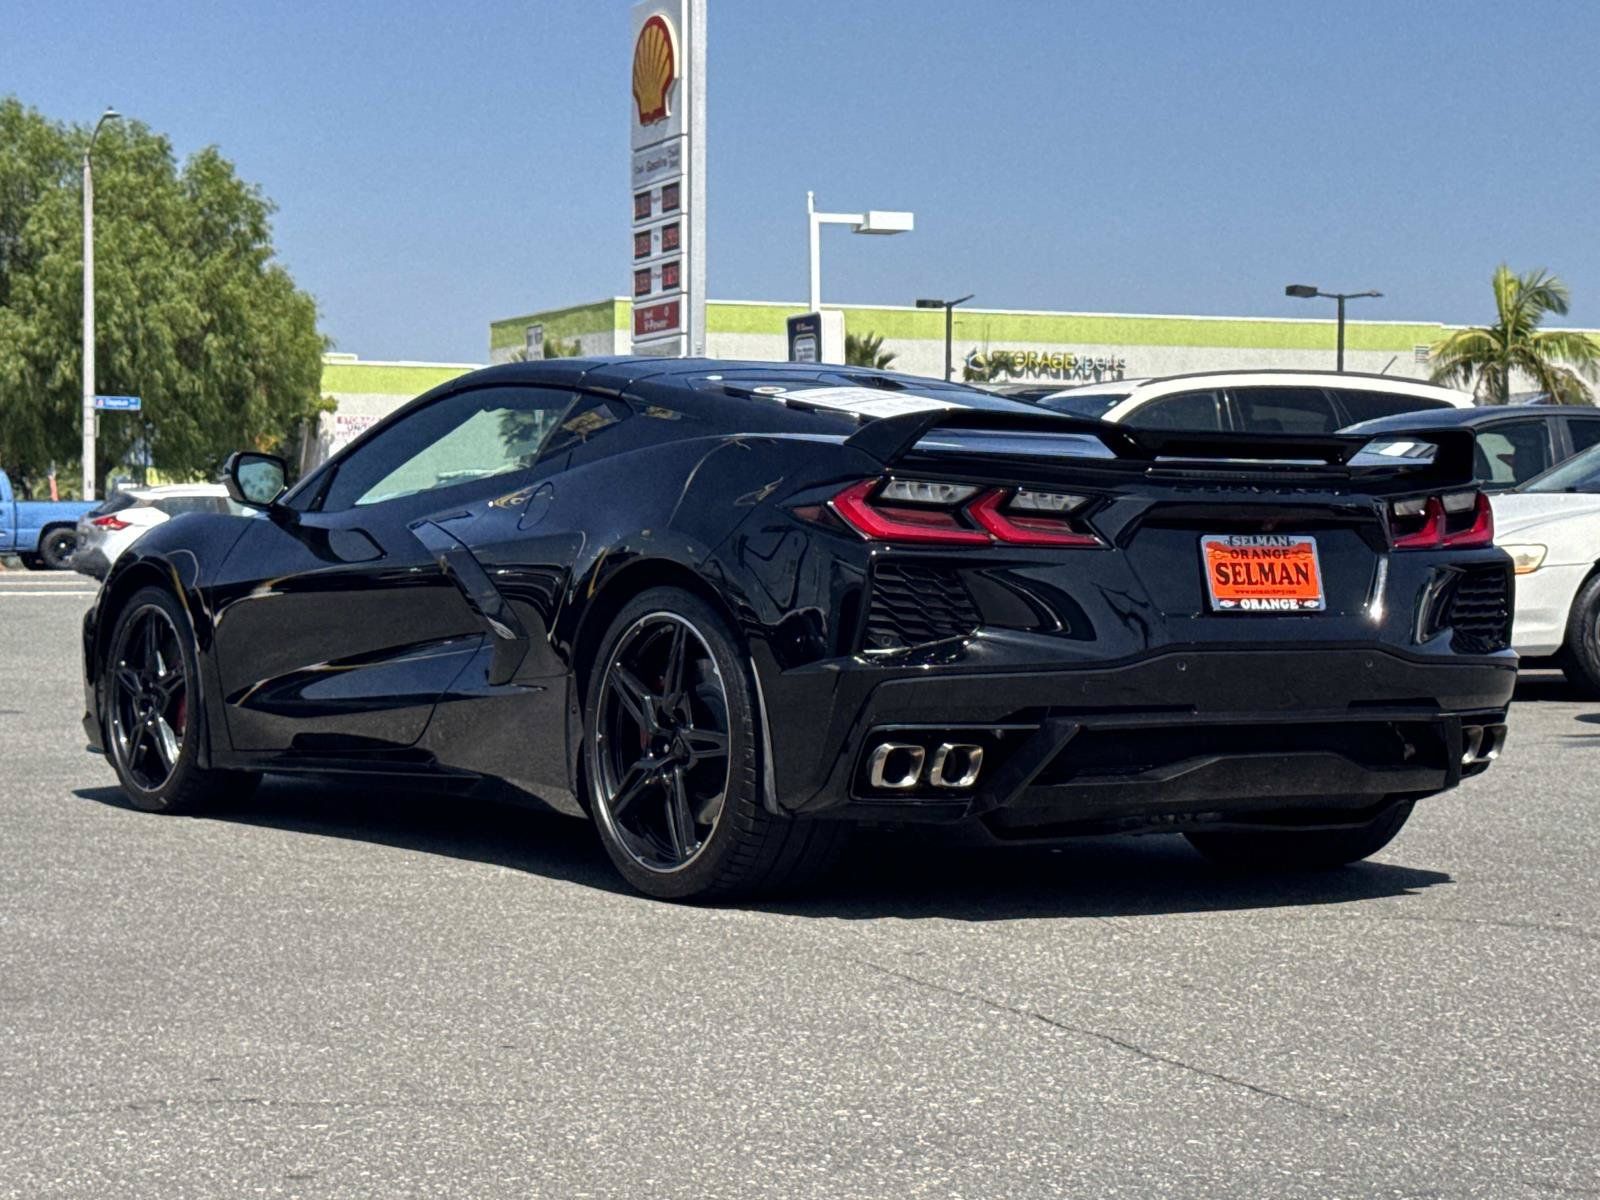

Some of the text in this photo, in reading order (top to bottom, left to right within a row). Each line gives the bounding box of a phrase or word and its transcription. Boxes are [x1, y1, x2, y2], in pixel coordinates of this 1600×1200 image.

[1230, 535, 1288, 547] SELMAN
[1231, 549, 1291, 560] ORANGE
[1215, 562, 1310, 586] SELMAN
[1240, 599, 1299, 610] ORANGE
